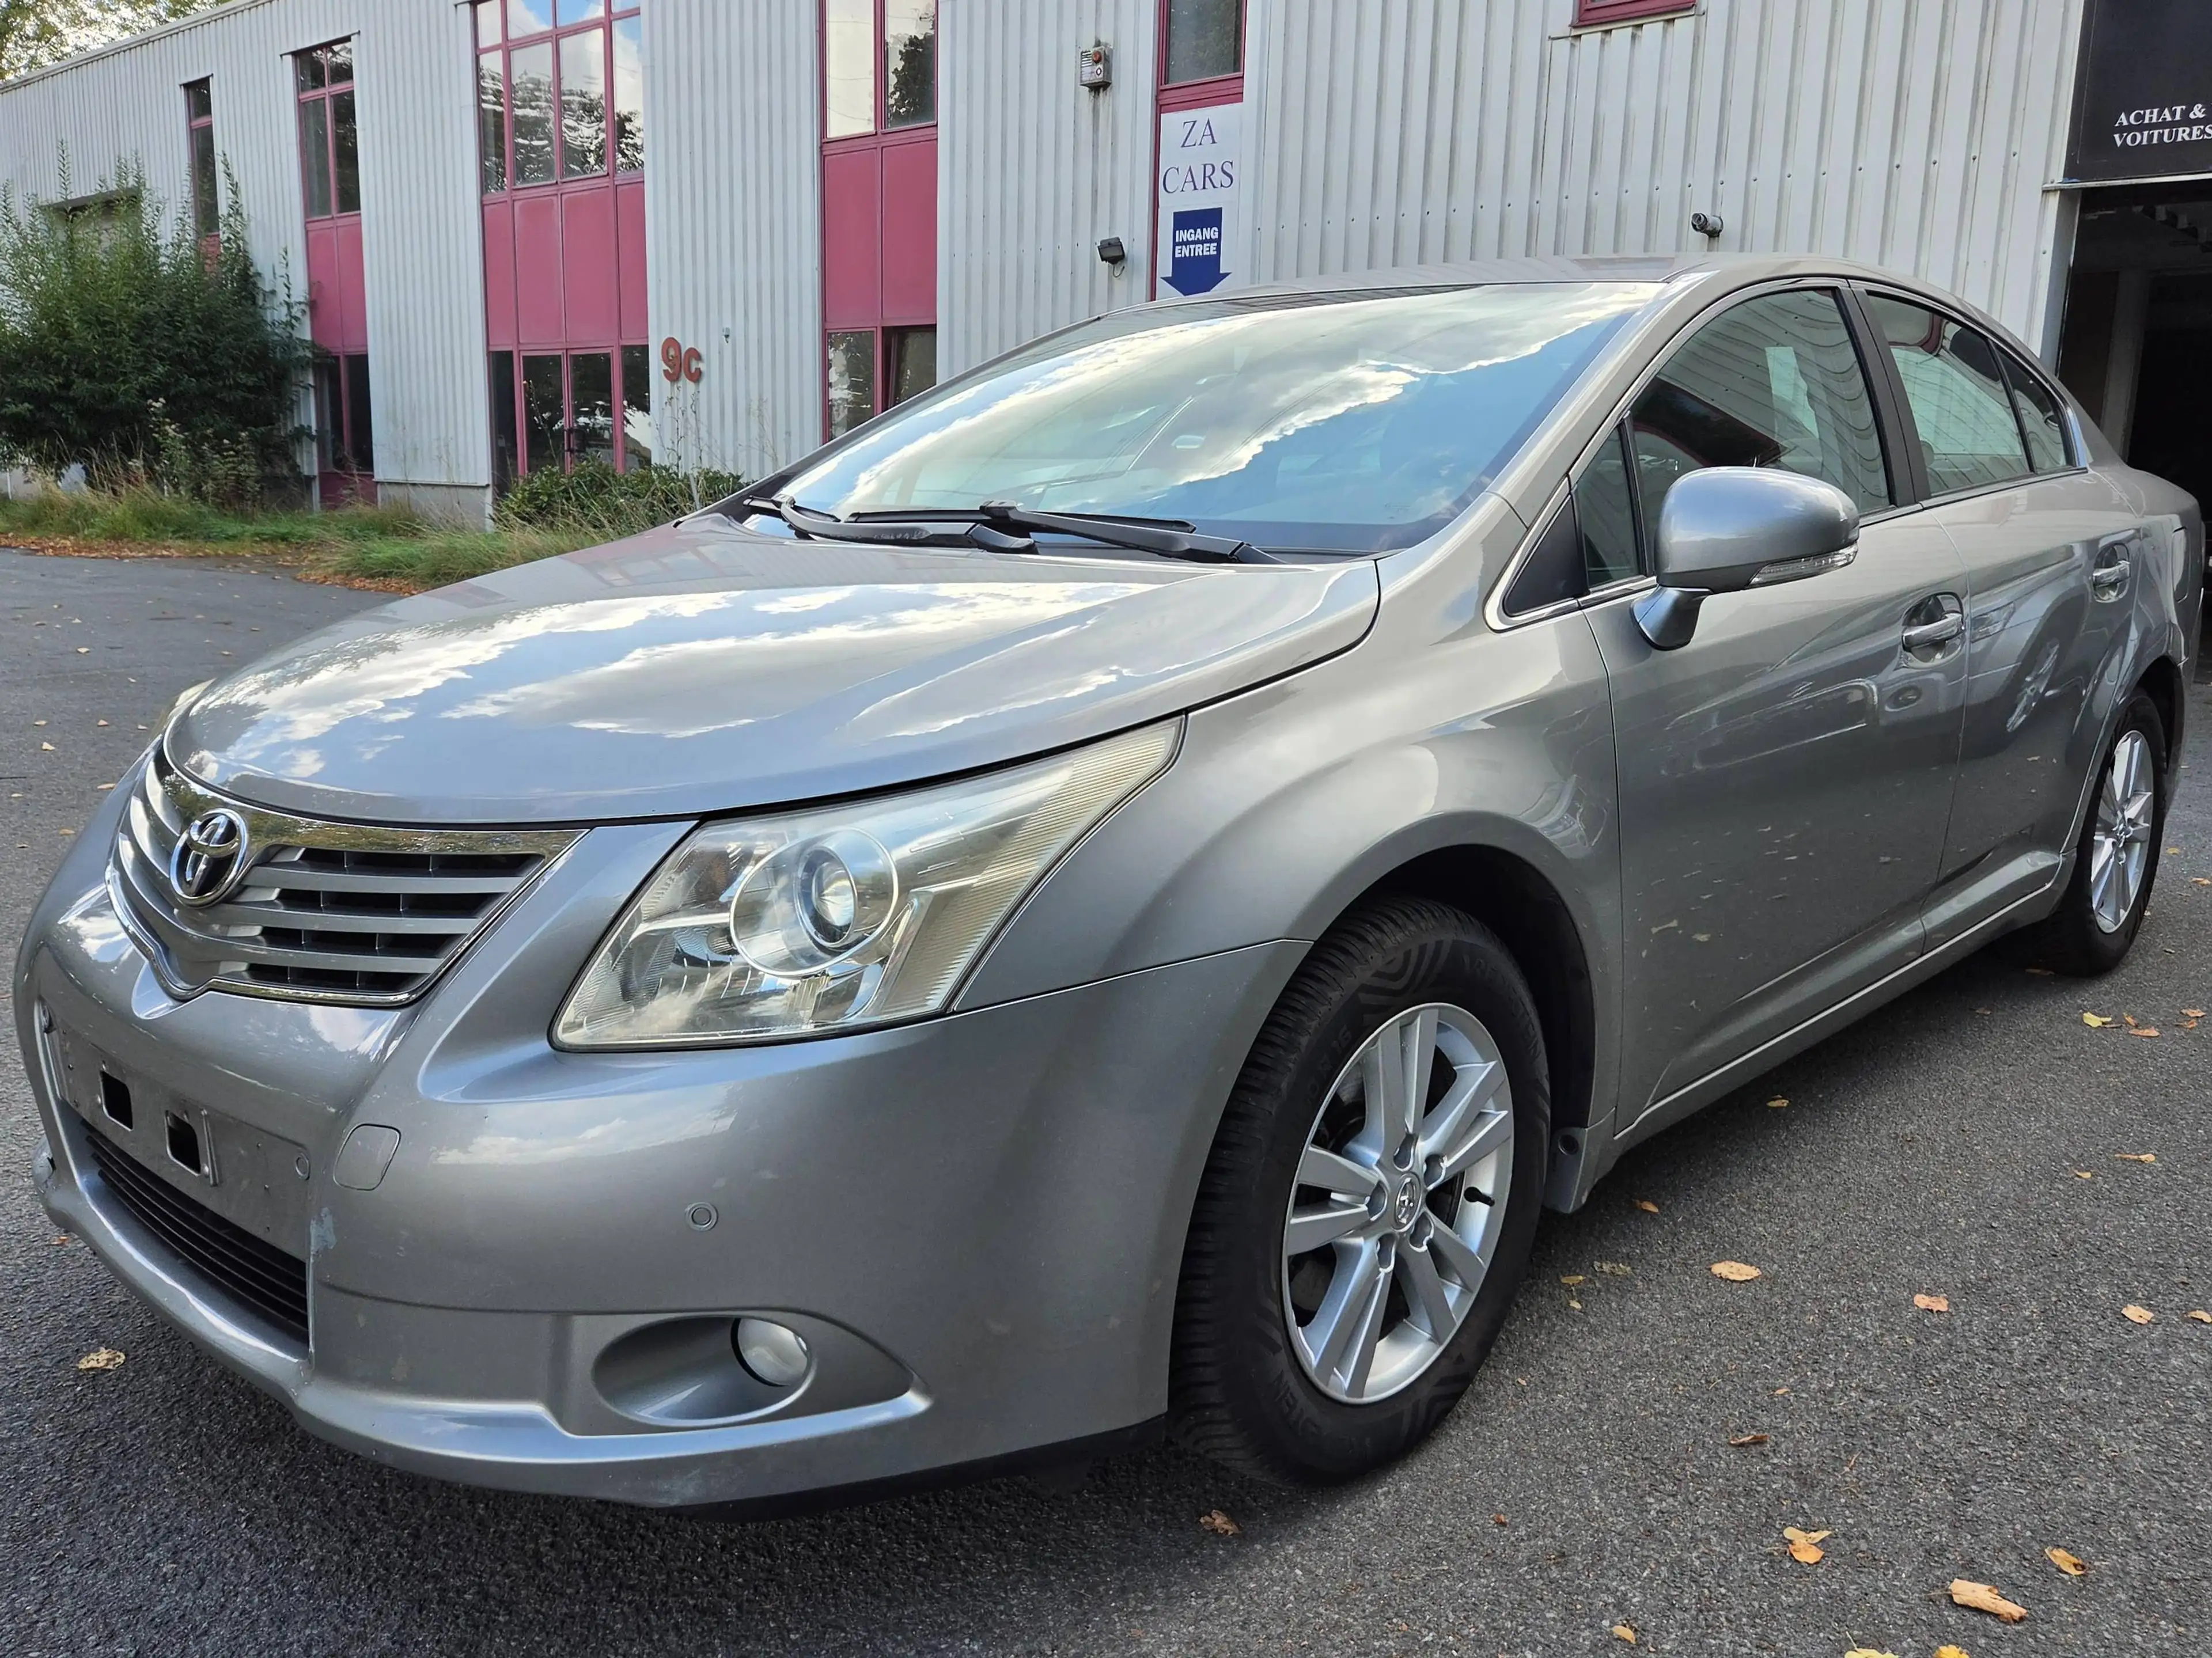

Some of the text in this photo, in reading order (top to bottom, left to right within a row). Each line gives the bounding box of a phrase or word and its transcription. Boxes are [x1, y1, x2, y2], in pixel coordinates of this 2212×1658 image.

[2114, 103, 2206, 127] ACHAT &
[1180, 117, 1218, 148] ZA
[2113, 124, 2212, 147] VOITURES
[1162, 160, 1234, 194] CARS
[1175, 226, 1219, 242] INGANG
[1175, 242, 1218, 258] ENTREE
